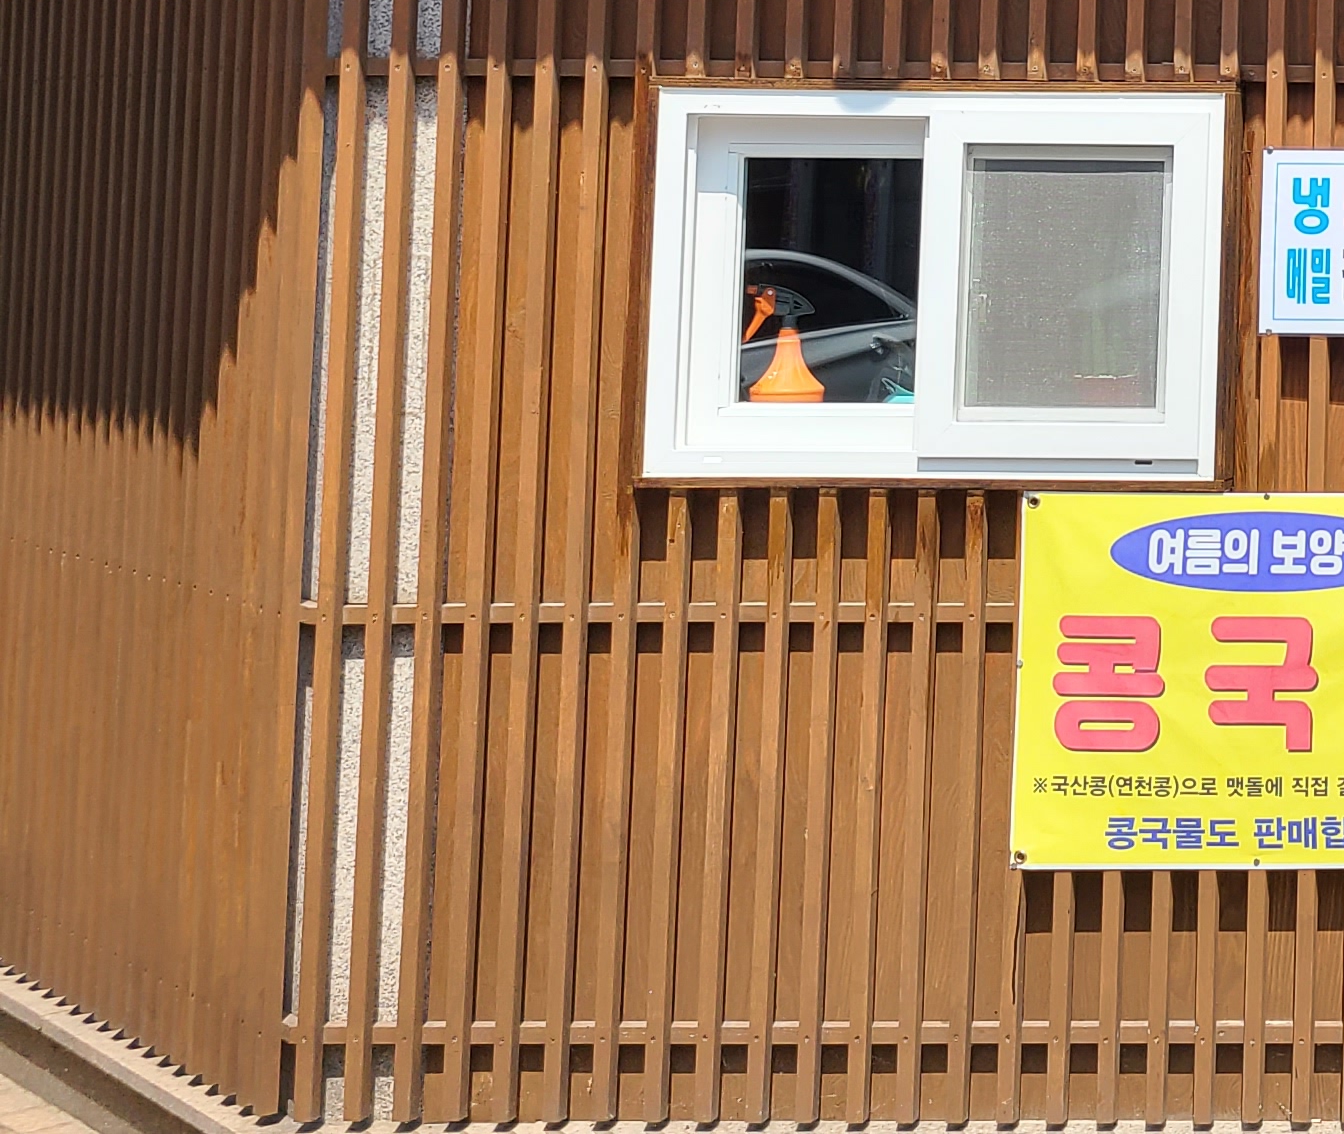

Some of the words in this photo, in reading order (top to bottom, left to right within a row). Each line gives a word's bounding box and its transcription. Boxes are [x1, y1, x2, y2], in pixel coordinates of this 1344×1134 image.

[1291, 177, 1331, 235] 냉
[1147, 528, 1261, 576] 여름의
[1225, 775, 1284, 799] 맷돌에
[1291, 776, 1329, 798] 직접
[1104, 817, 1240, 850] 콩국물도
